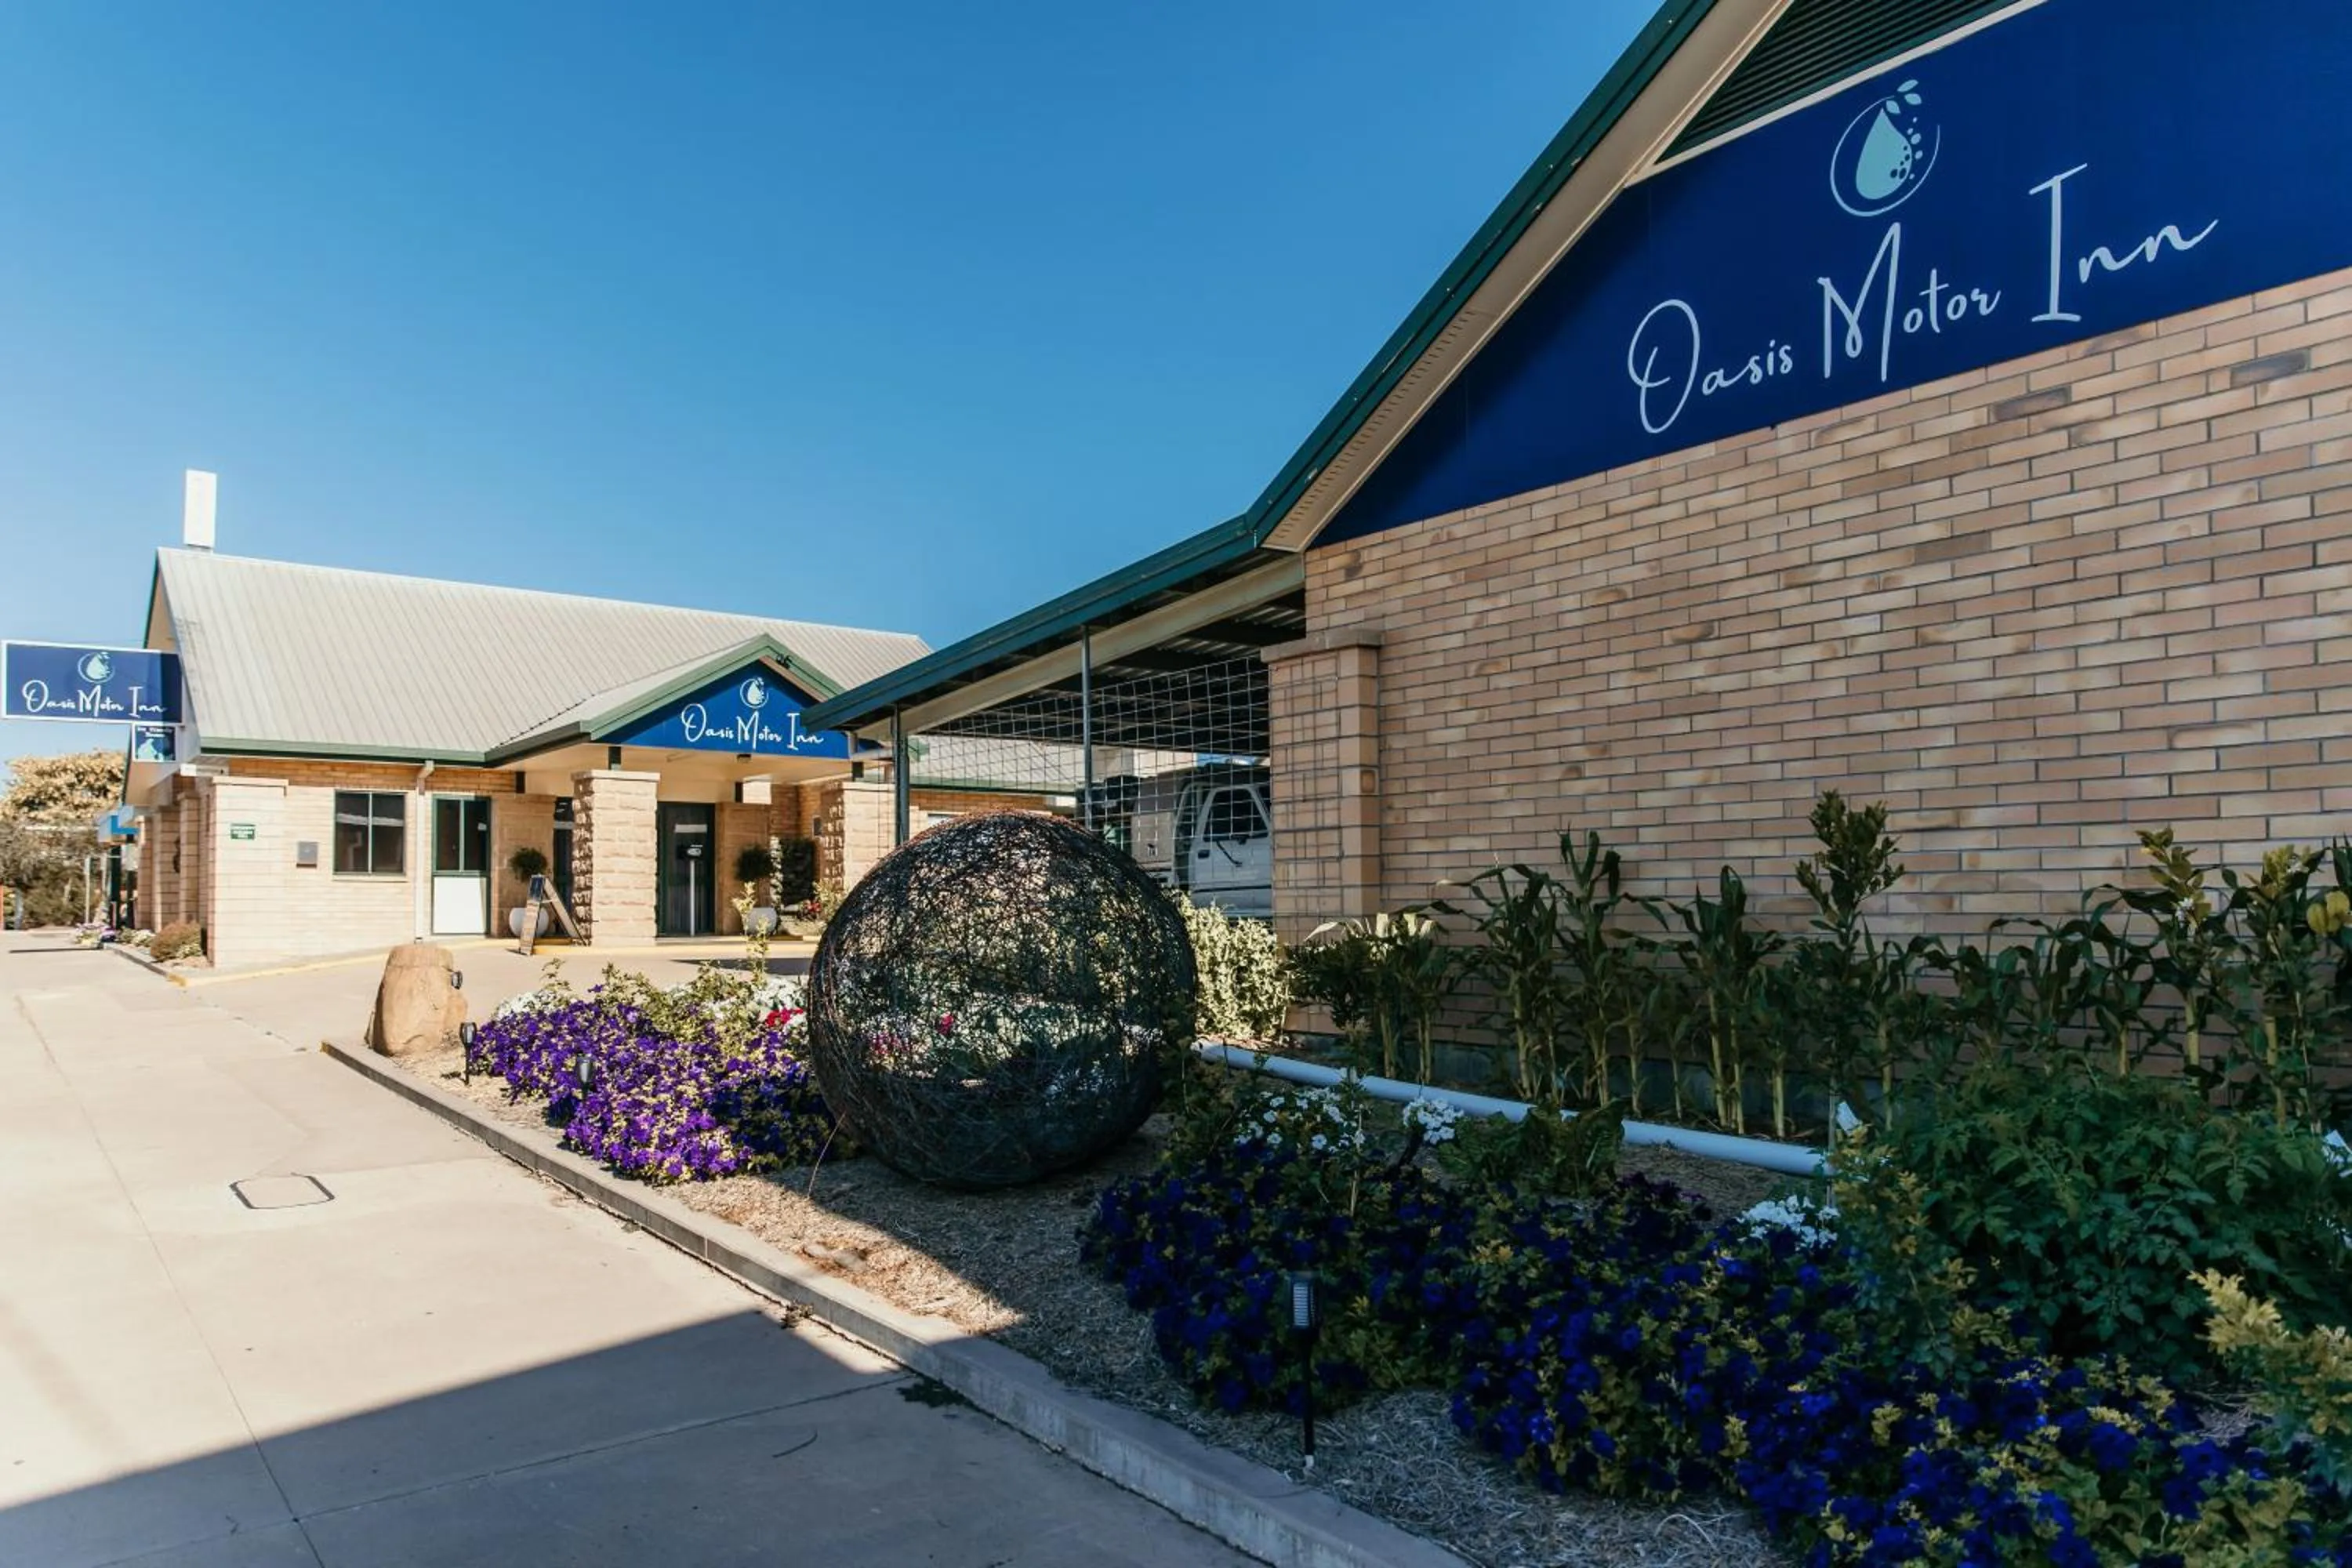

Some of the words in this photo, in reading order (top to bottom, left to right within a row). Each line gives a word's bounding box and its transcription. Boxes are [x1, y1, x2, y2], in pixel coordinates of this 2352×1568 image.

[1628, 299, 1793, 433] Oasis
[1817, 222, 2001, 382] Motor
[2029, 162, 2218, 322] Inn
[22, 680, 75, 713] Oasis
[77, 684, 124, 717] Motor
[128, 686, 167, 718] Inn
[681, 703, 734, 742] Oasis
[736, 710, 782, 750] Motor
[786, 713, 824, 750] Inn
